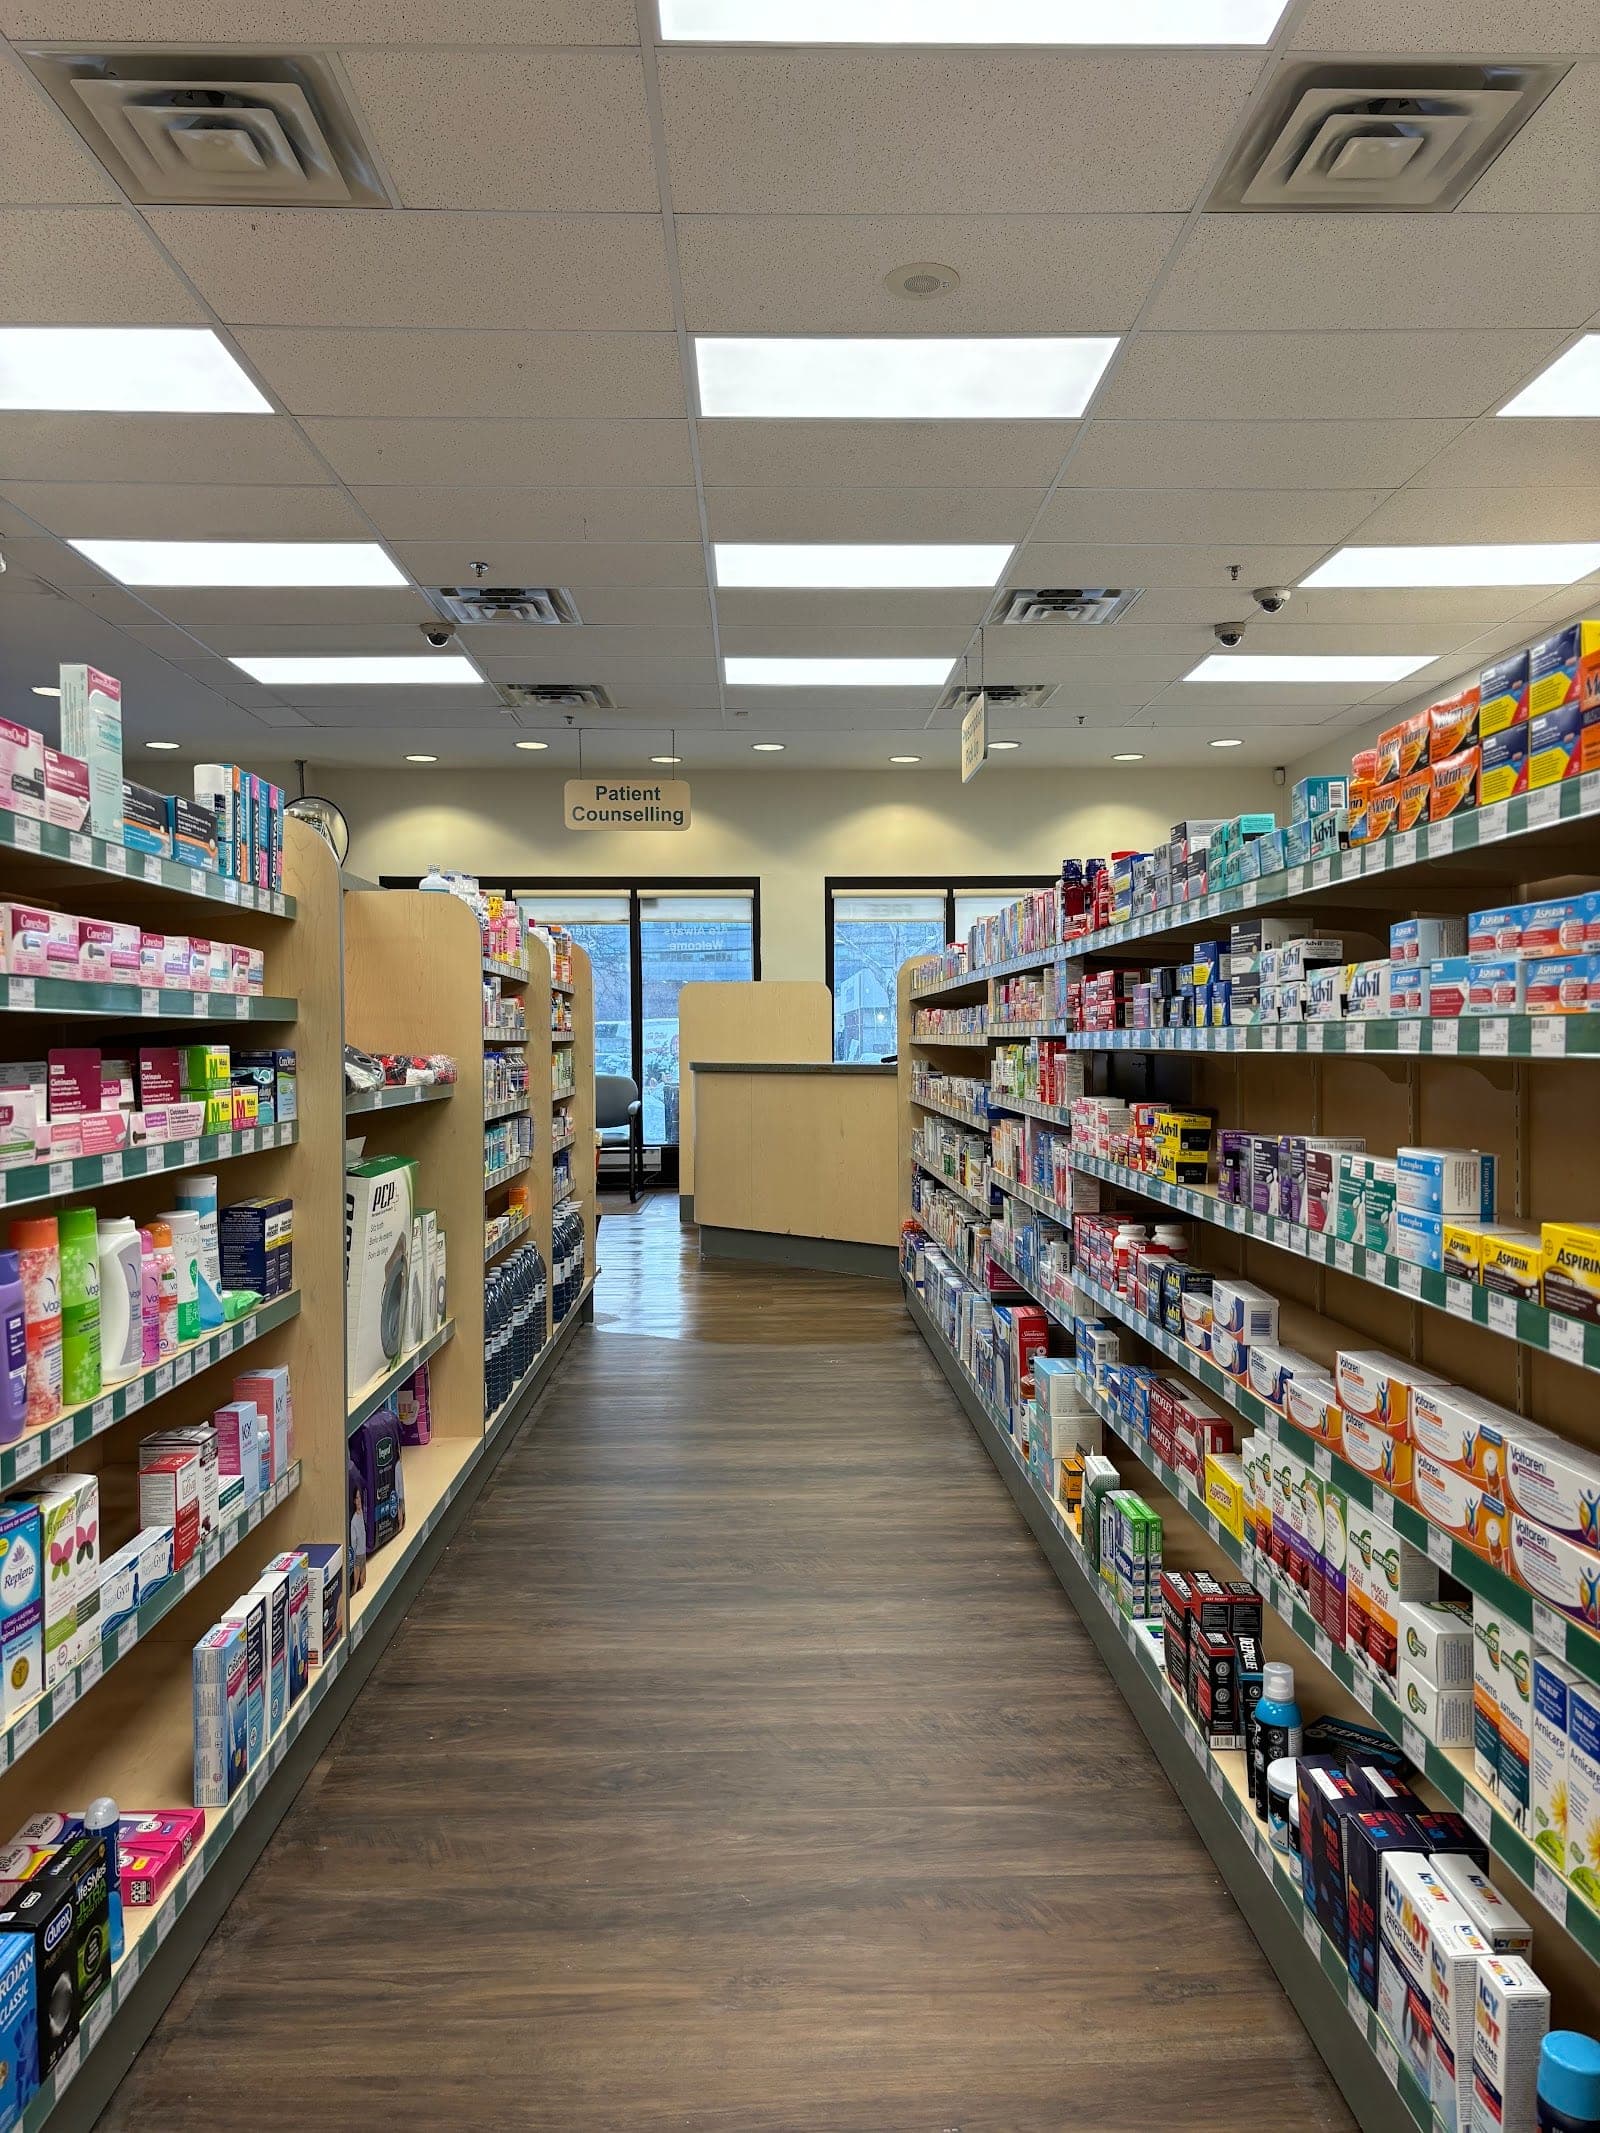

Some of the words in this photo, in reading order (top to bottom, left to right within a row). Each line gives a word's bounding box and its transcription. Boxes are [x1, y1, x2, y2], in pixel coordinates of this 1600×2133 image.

[595, 785, 661, 801] Patient
[572, 807, 684, 825] Counselling
[1312, 817, 1336, 843] Advil
[1311, 979, 1333, 1002] Advil
[1351, 971, 1380, 999] Advil
[1158, 1120, 1178, 1138] Advil
[1160, 1154, 1174, 1171] Advil
[372, 1182, 395, 1212] PCP
[1449, 1238, 1471, 1254] ASPIRIN
[1496, 1250, 1528, 1271] ASPIRIN
[1414, 1392, 1436, 1412] Voltaren
[1418, 1454, 1438, 1475] Voltaren
[1509, 1446, 1544, 1472] Voltaren
[1515, 1519, 1547, 1546] Voltaren
[4, 1565, 35, 1589] Replens
[1371, 1581, 1389, 1601] MUSCLE
[1534, 1717, 1565, 1750] Arnicare
[1570, 1748, 1600, 1784] Arnicare
[47, 1910, 70, 1943] durex
[0, 1945, 35, 1997] ROJAN
[0, 1978, 29, 2026] CLASSIC
[1479, 1977, 1498, 2018] ICY
[1476, 2001, 1500, 2044] HOT
